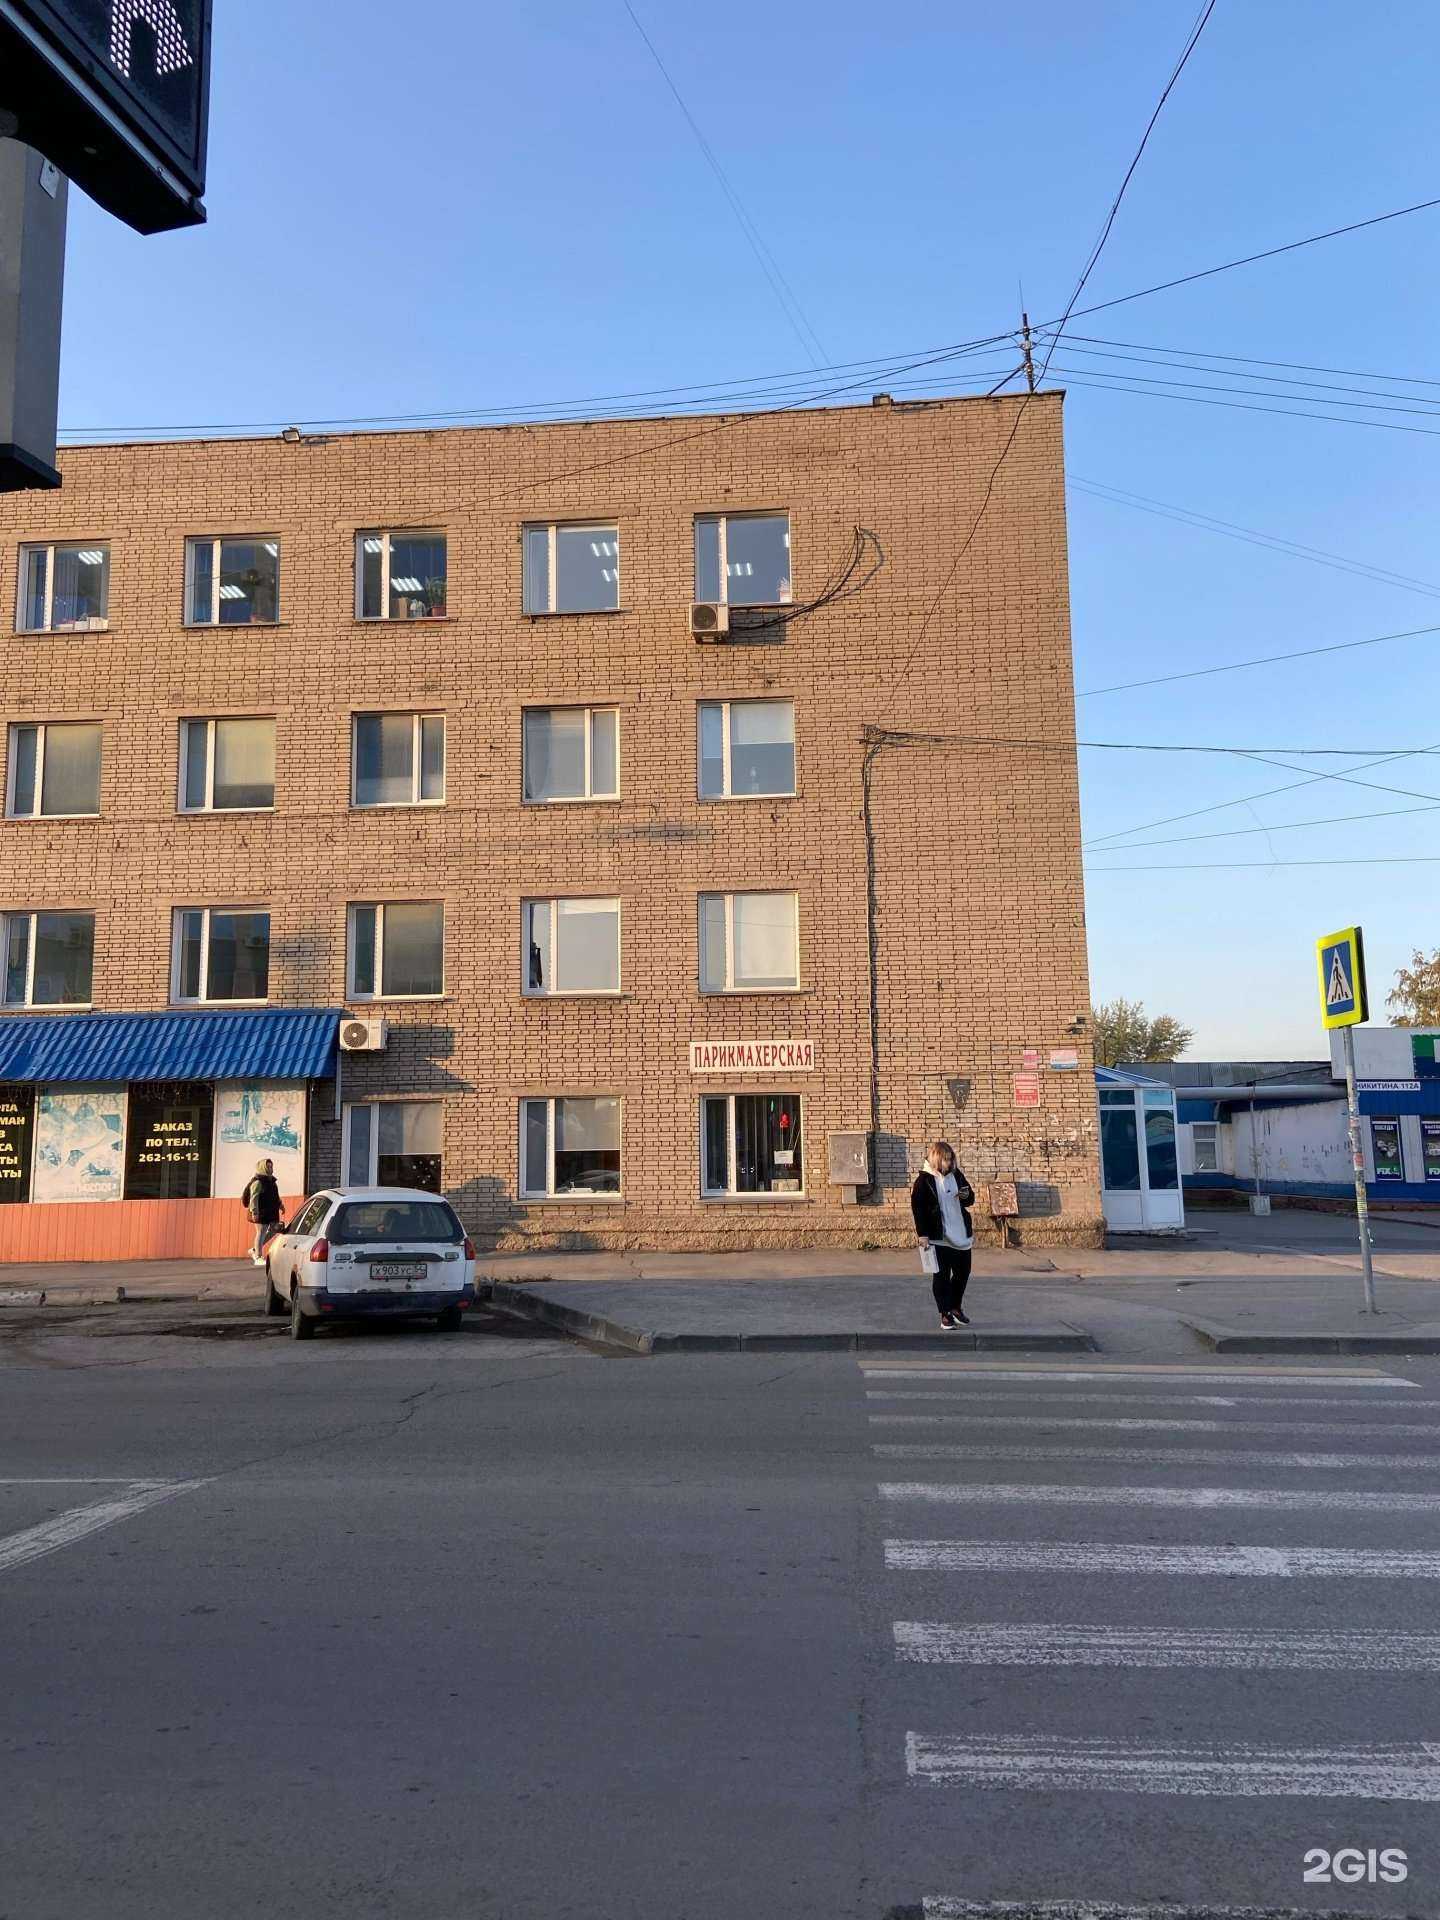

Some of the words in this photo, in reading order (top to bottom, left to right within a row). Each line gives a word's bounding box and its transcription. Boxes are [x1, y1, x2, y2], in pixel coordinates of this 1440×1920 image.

[694, 1044, 812, 1067] ПАРИКМАХЕРСКАЯ
[153, 1122, 193, 1132] ЗАКАЗ
[145, 1138, 164, 1148] ПО
[165, 1138, 197, 1147] ТЕЛ.:
[138, 1152, 200, 1162] 262-16-12
